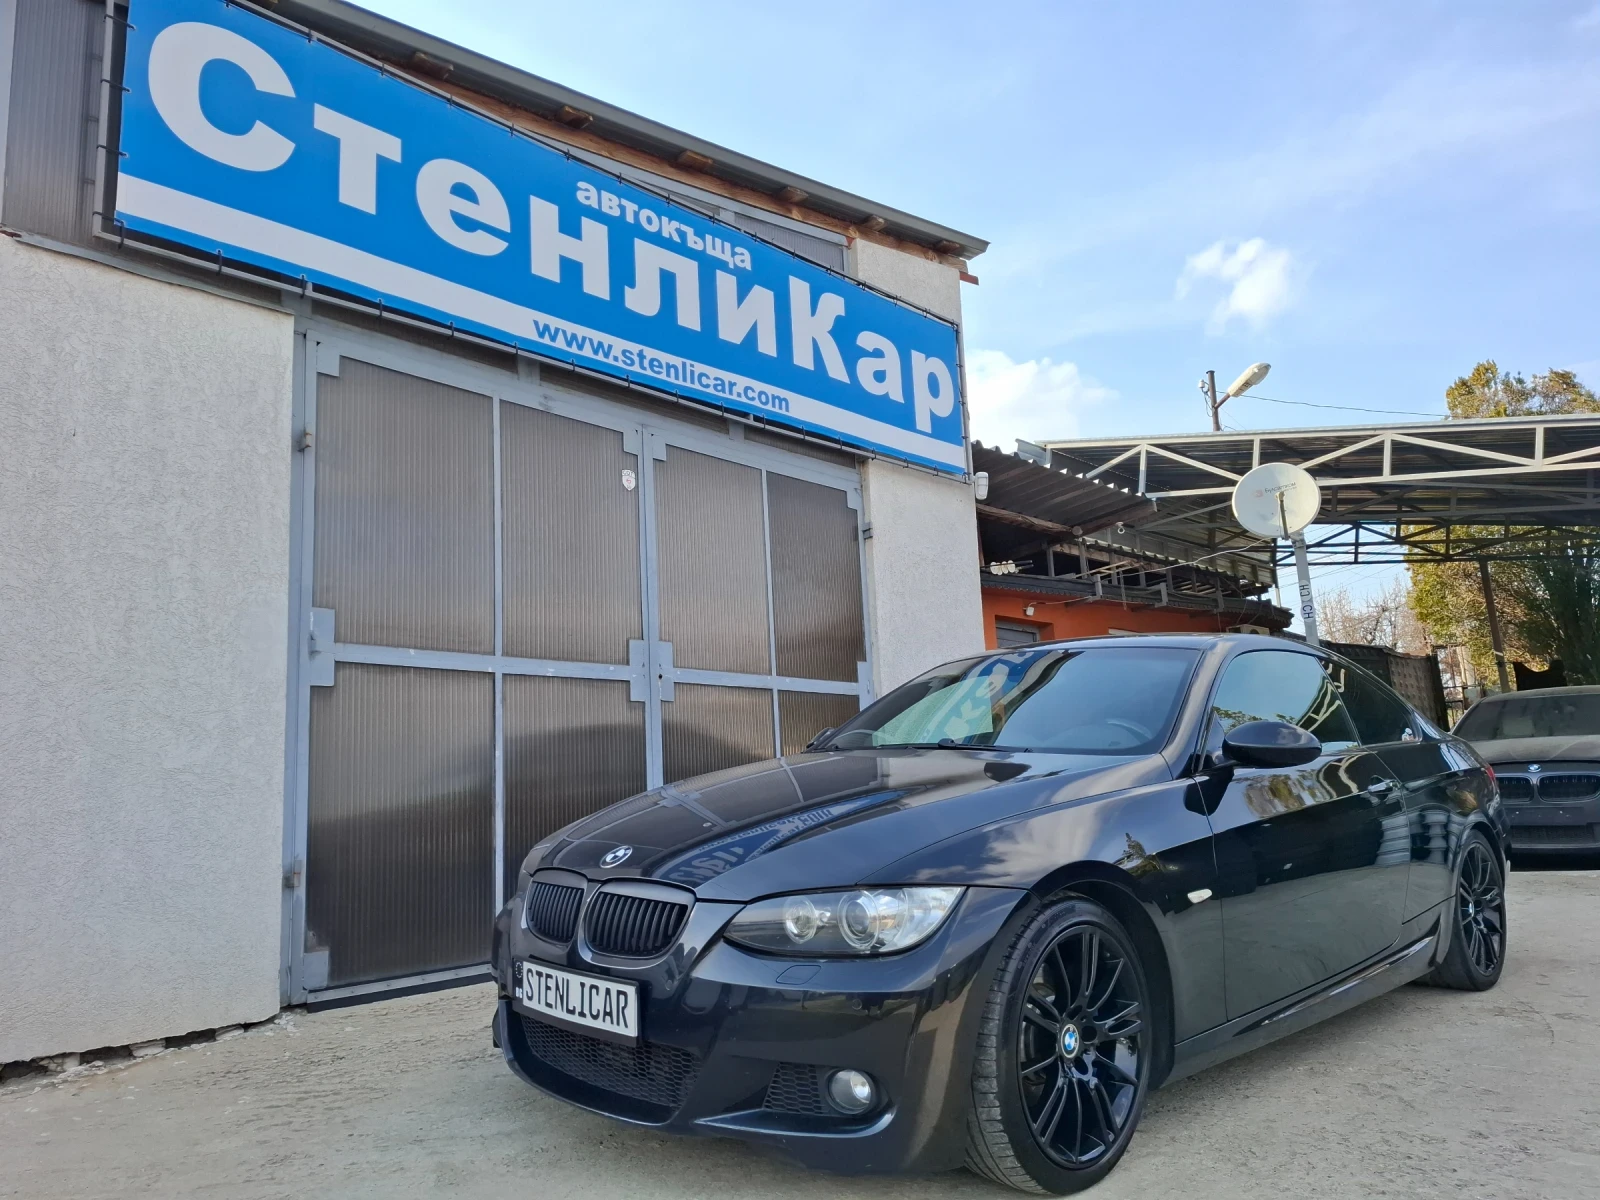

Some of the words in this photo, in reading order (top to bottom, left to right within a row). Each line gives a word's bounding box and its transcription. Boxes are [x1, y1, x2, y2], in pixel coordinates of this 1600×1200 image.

[148, 23, 954, 432] СтенлиКар
[576, 181, 751, 270] автокъща
[533, 319, 790, 413] www.stenlicar.com
[525, 967, 629, 1029] STENLICAR
